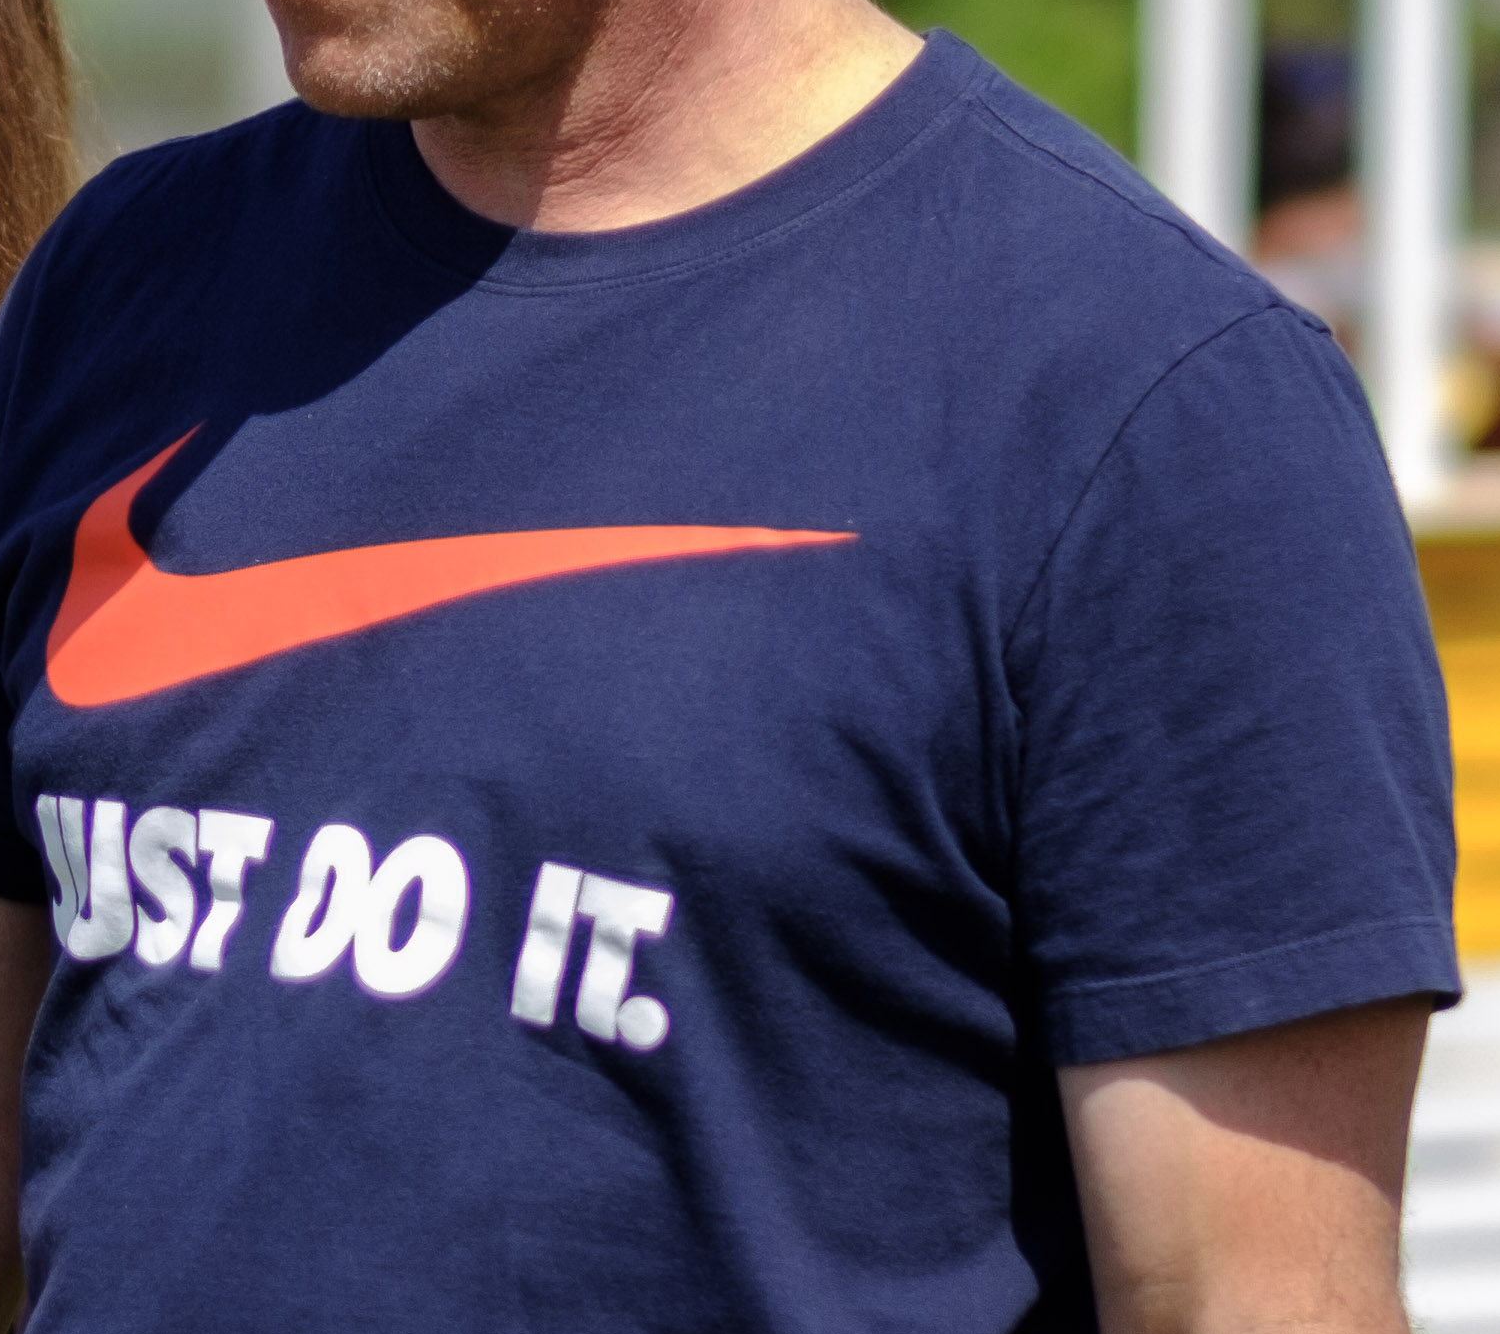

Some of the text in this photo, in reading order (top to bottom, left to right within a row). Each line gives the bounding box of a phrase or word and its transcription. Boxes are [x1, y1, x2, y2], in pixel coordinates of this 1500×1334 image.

[36, 792, 674, 1051] JUST DO IT.
